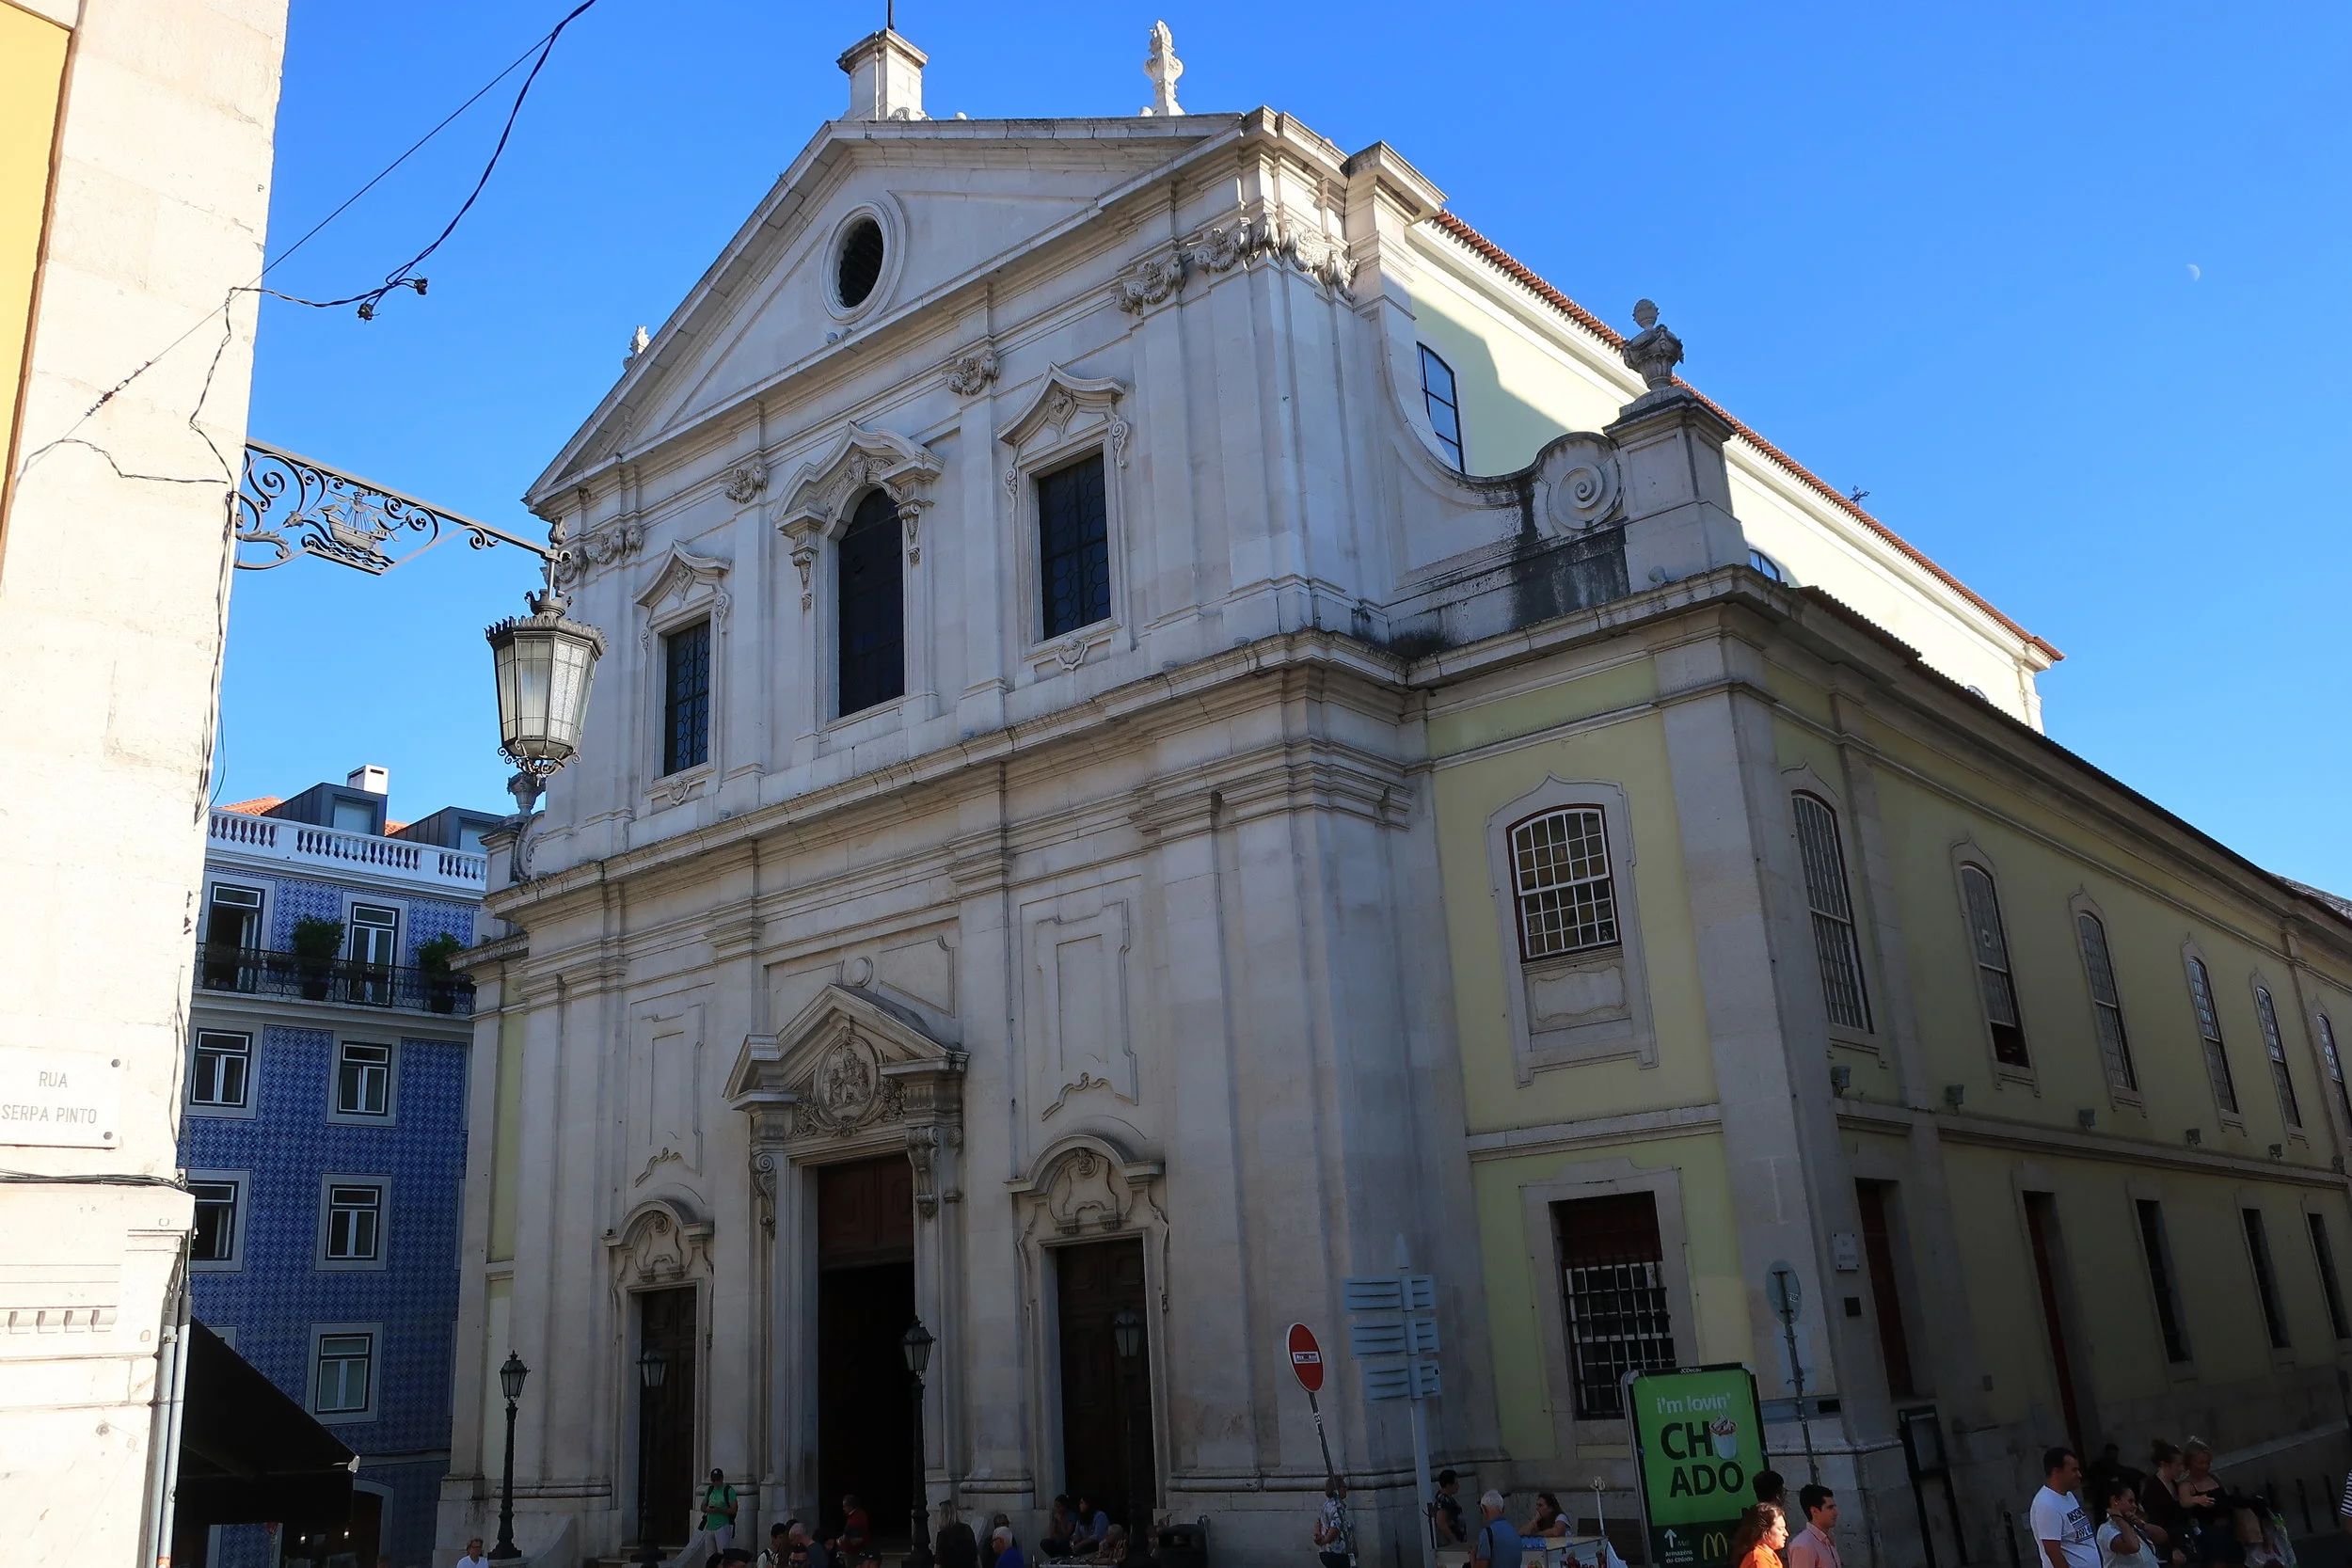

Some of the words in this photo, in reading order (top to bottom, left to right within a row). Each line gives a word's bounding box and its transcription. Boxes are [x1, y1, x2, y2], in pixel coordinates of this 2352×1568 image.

[39, 1070, 68, 1088] RUA
[1, 1103, 49, 1122] SERPA
[56, 1107, 97, 1124] PINTO
[1656, 1397, 1683, 1415] i'm
[1686, 1392, 1731, 1412] lovin'
